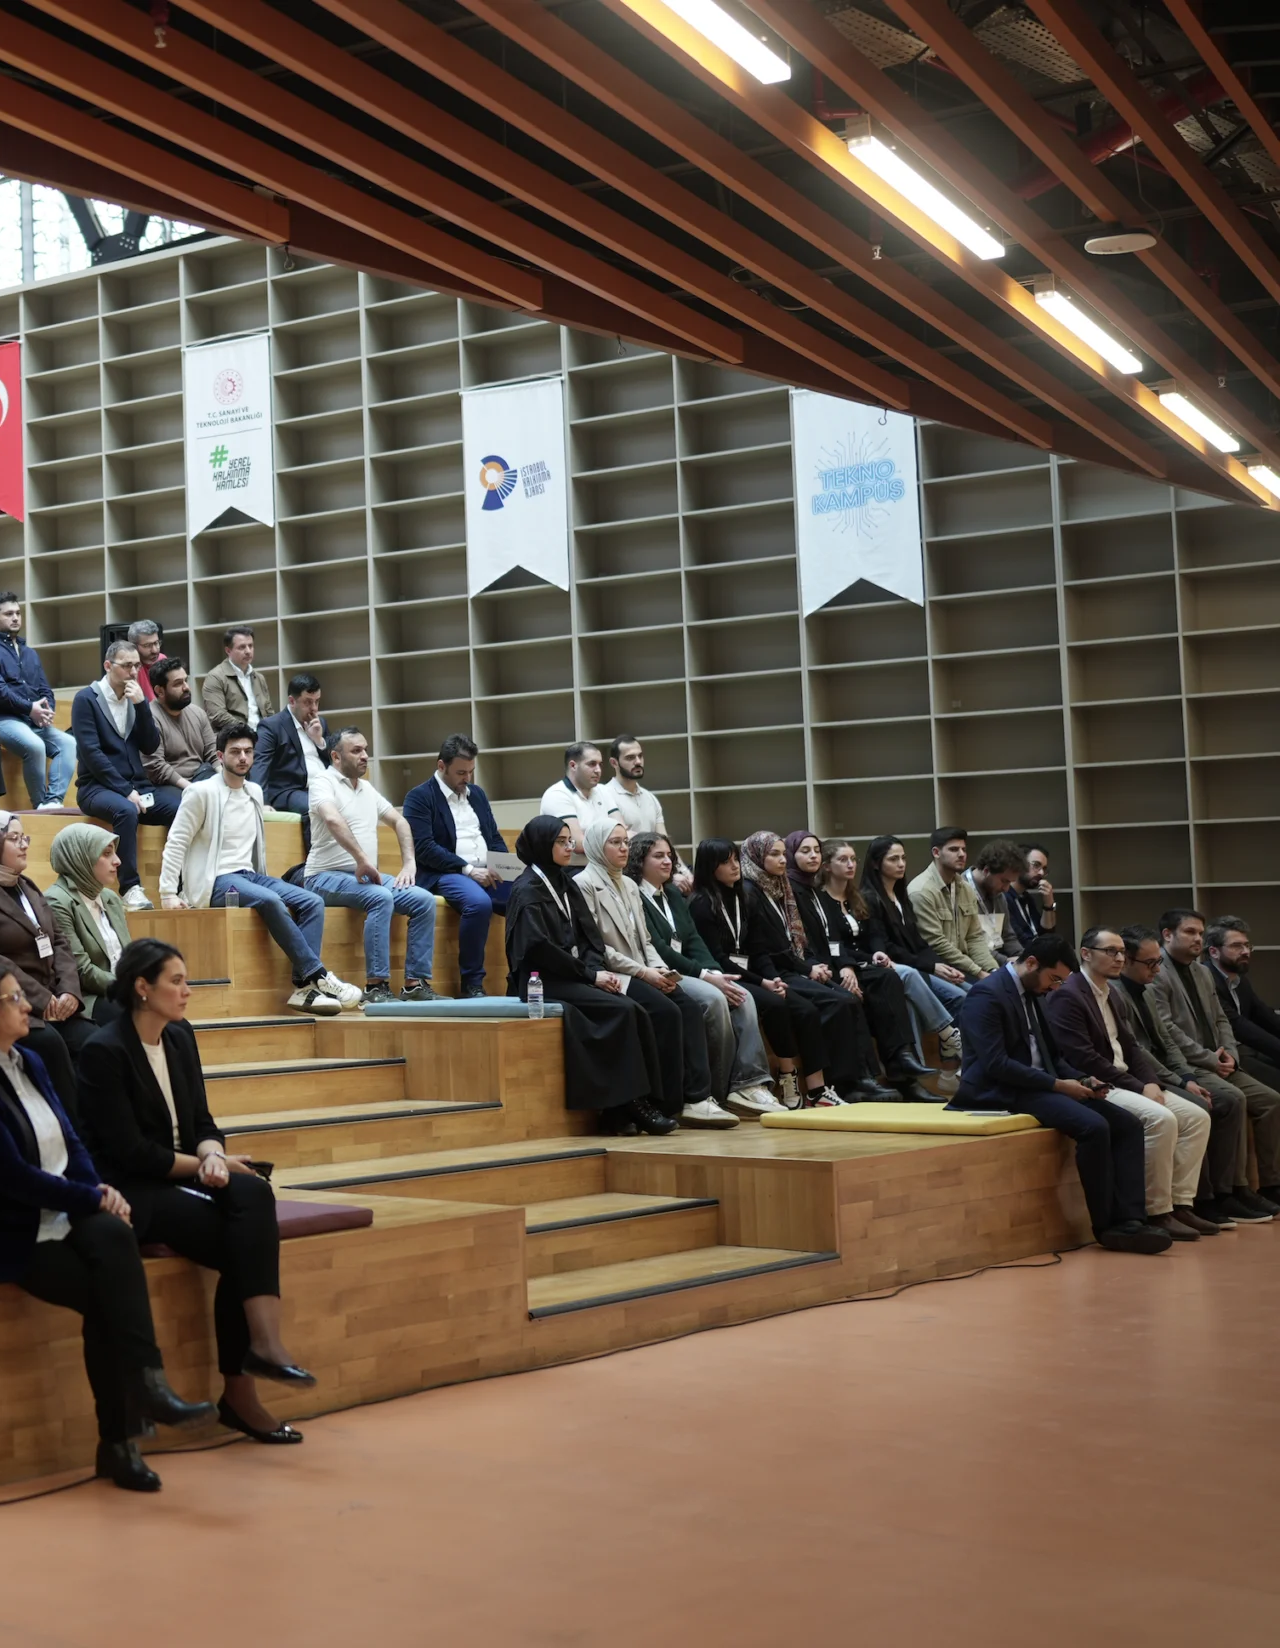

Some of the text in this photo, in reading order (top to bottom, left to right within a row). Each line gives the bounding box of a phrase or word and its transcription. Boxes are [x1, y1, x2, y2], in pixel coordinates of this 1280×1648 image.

[196, 411, 263, 429] TEKNOLOJİ BAKANLIĞI
[241, 405, 249, 413] VE
[819, 458, 895, 491] TEKNO
[812, 478, 905, 516] KAMPÜS
